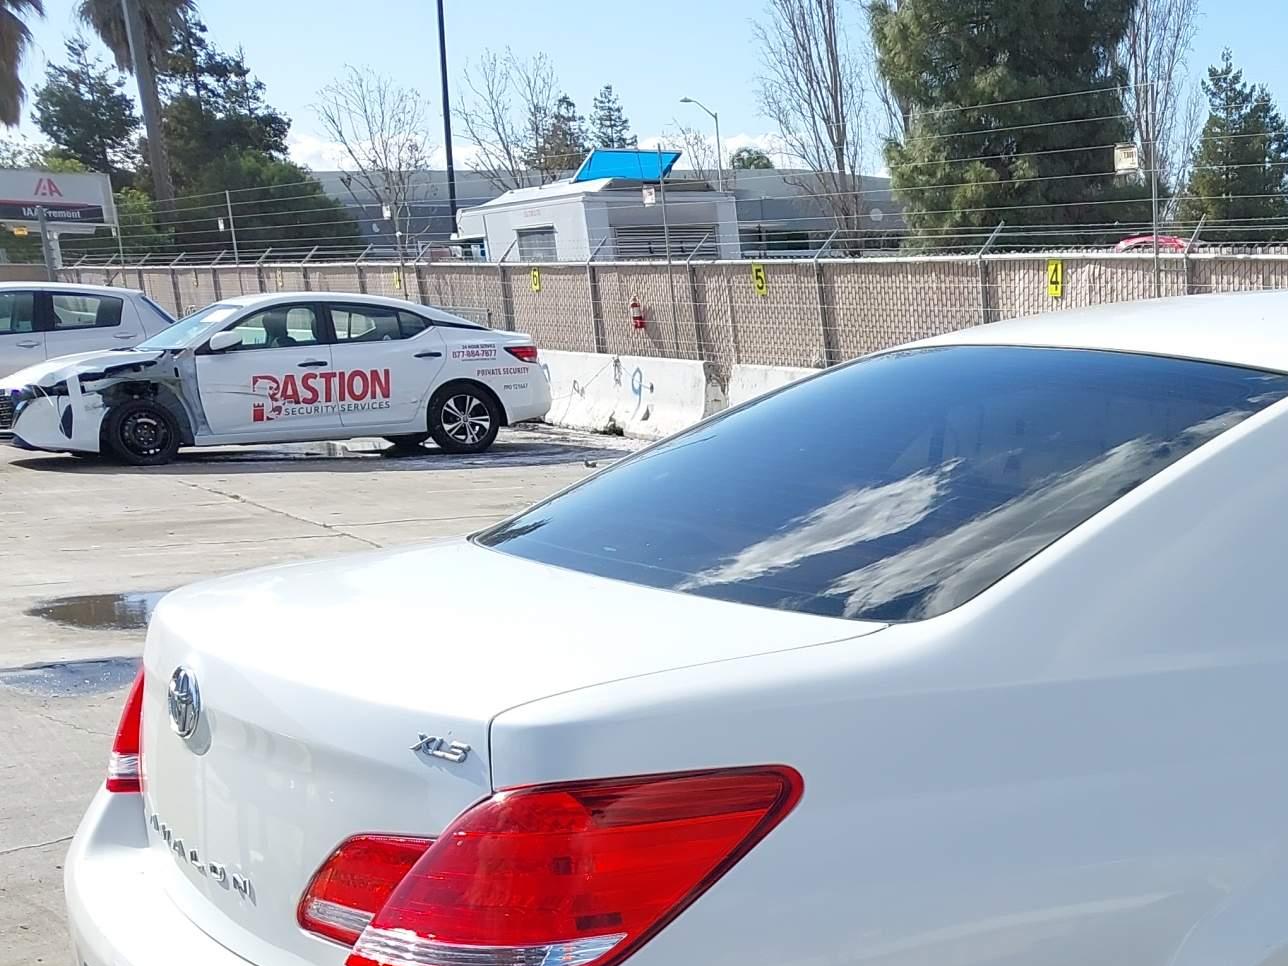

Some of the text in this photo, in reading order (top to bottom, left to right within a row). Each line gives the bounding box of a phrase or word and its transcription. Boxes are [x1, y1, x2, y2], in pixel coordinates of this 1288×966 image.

[755, 268, 764, 290] 5
[1050, 263, 1060, 292] 4
[476, 366, 529, 377] PRIVATE SECURITY
[285, 400, 391, 416] SECURITY SERVICES
[409, 731, 471, 763] XLS
